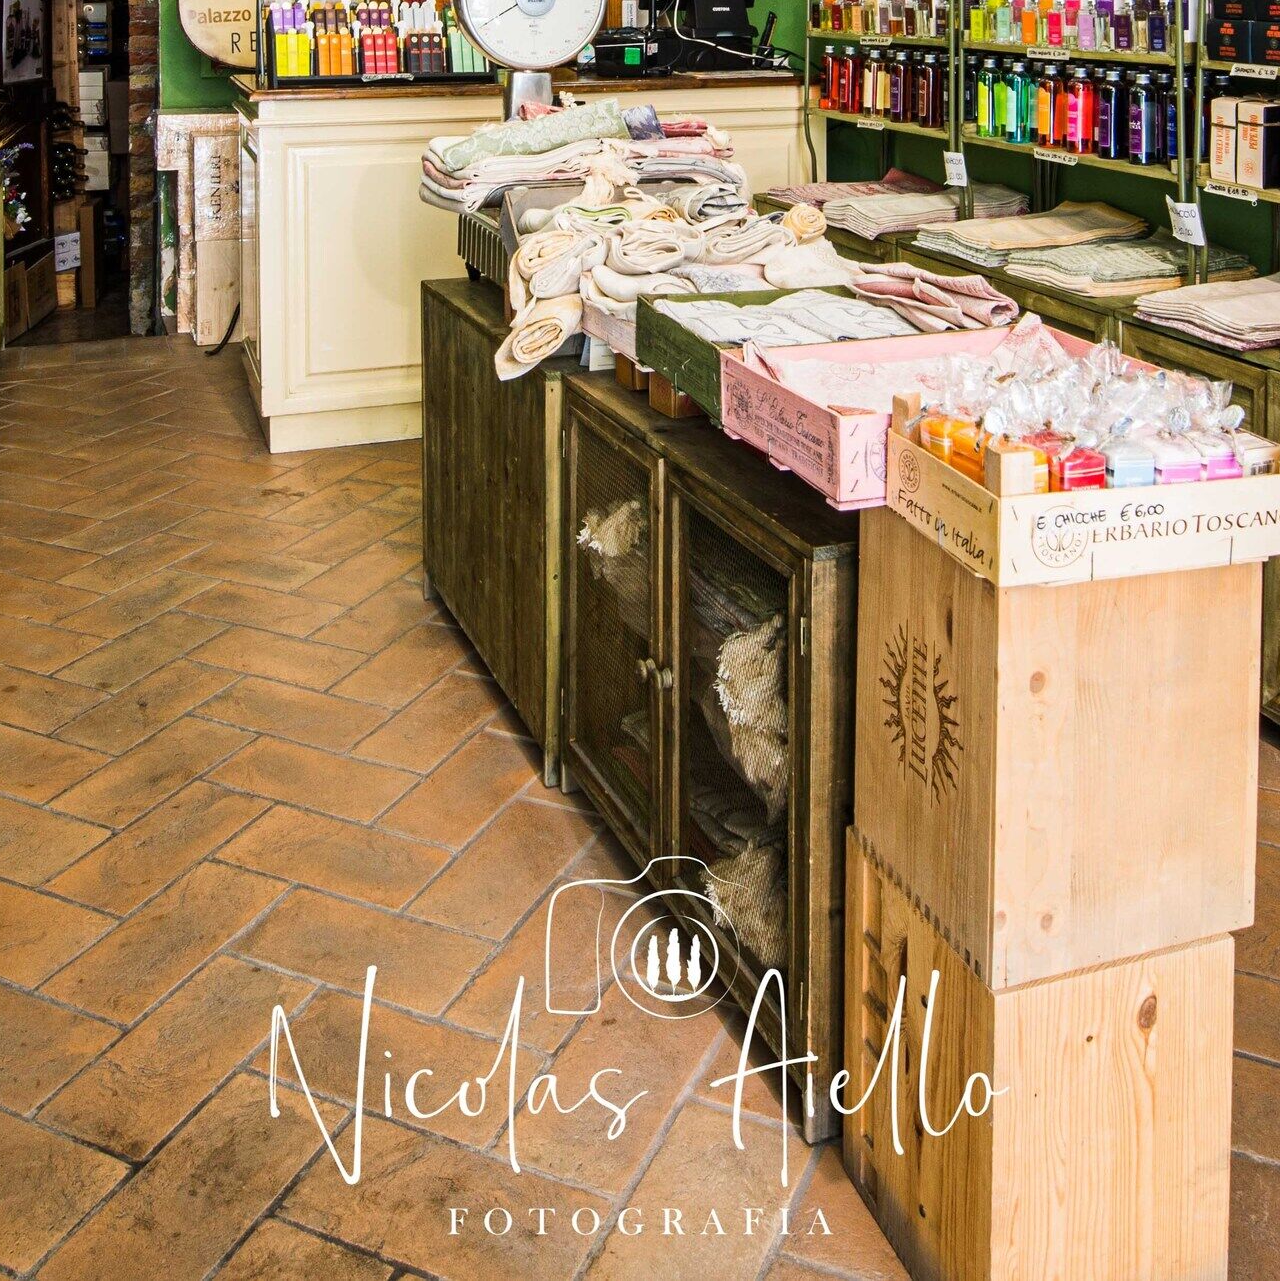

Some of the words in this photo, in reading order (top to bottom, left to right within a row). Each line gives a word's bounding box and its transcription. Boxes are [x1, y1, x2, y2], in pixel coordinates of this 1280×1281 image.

[897, 488, 932, 526] Fatto
[934, 510, 949, 537] in
[951, 526, 985, 566] Italia
[1092, 518, 1188, 544] ERBARIO
[1038, 539, 1083, 563] TOSCANO
